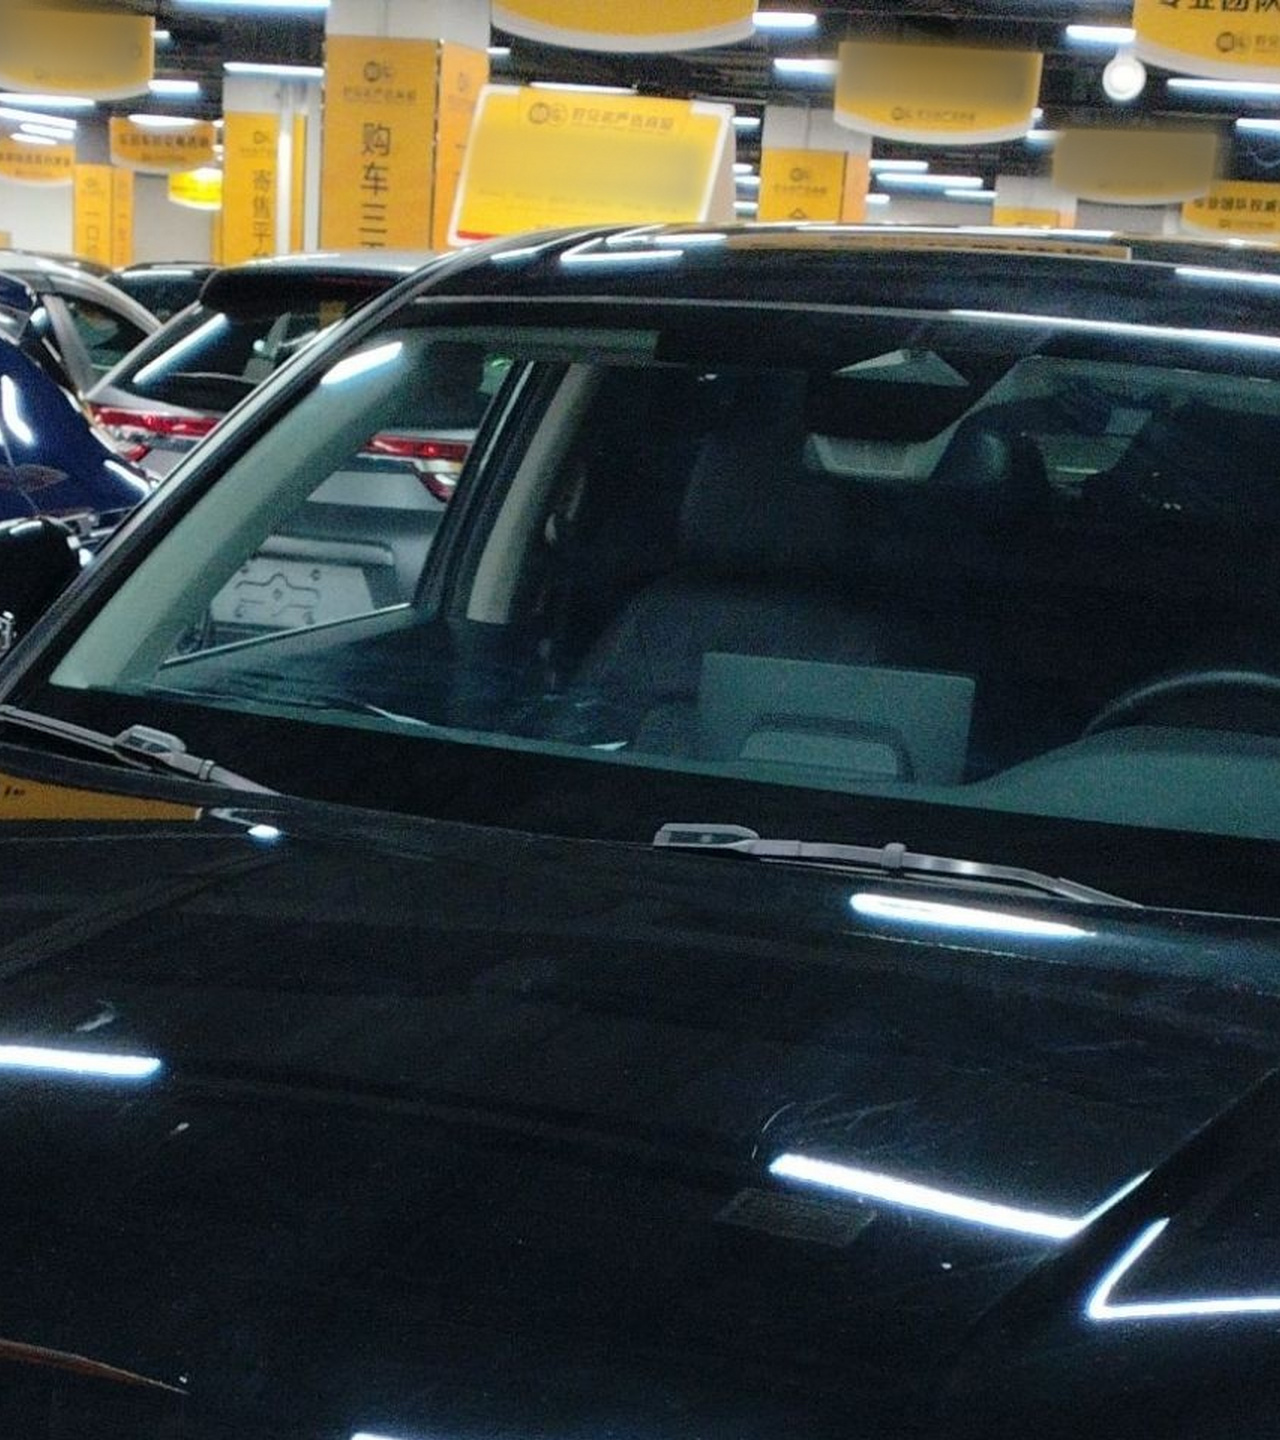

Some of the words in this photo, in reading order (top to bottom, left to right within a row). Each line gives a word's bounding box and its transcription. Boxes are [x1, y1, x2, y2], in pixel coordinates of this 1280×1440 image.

[252, 169, 272, 257] 寄售平
[358, 122, 392, 248] 购车三
